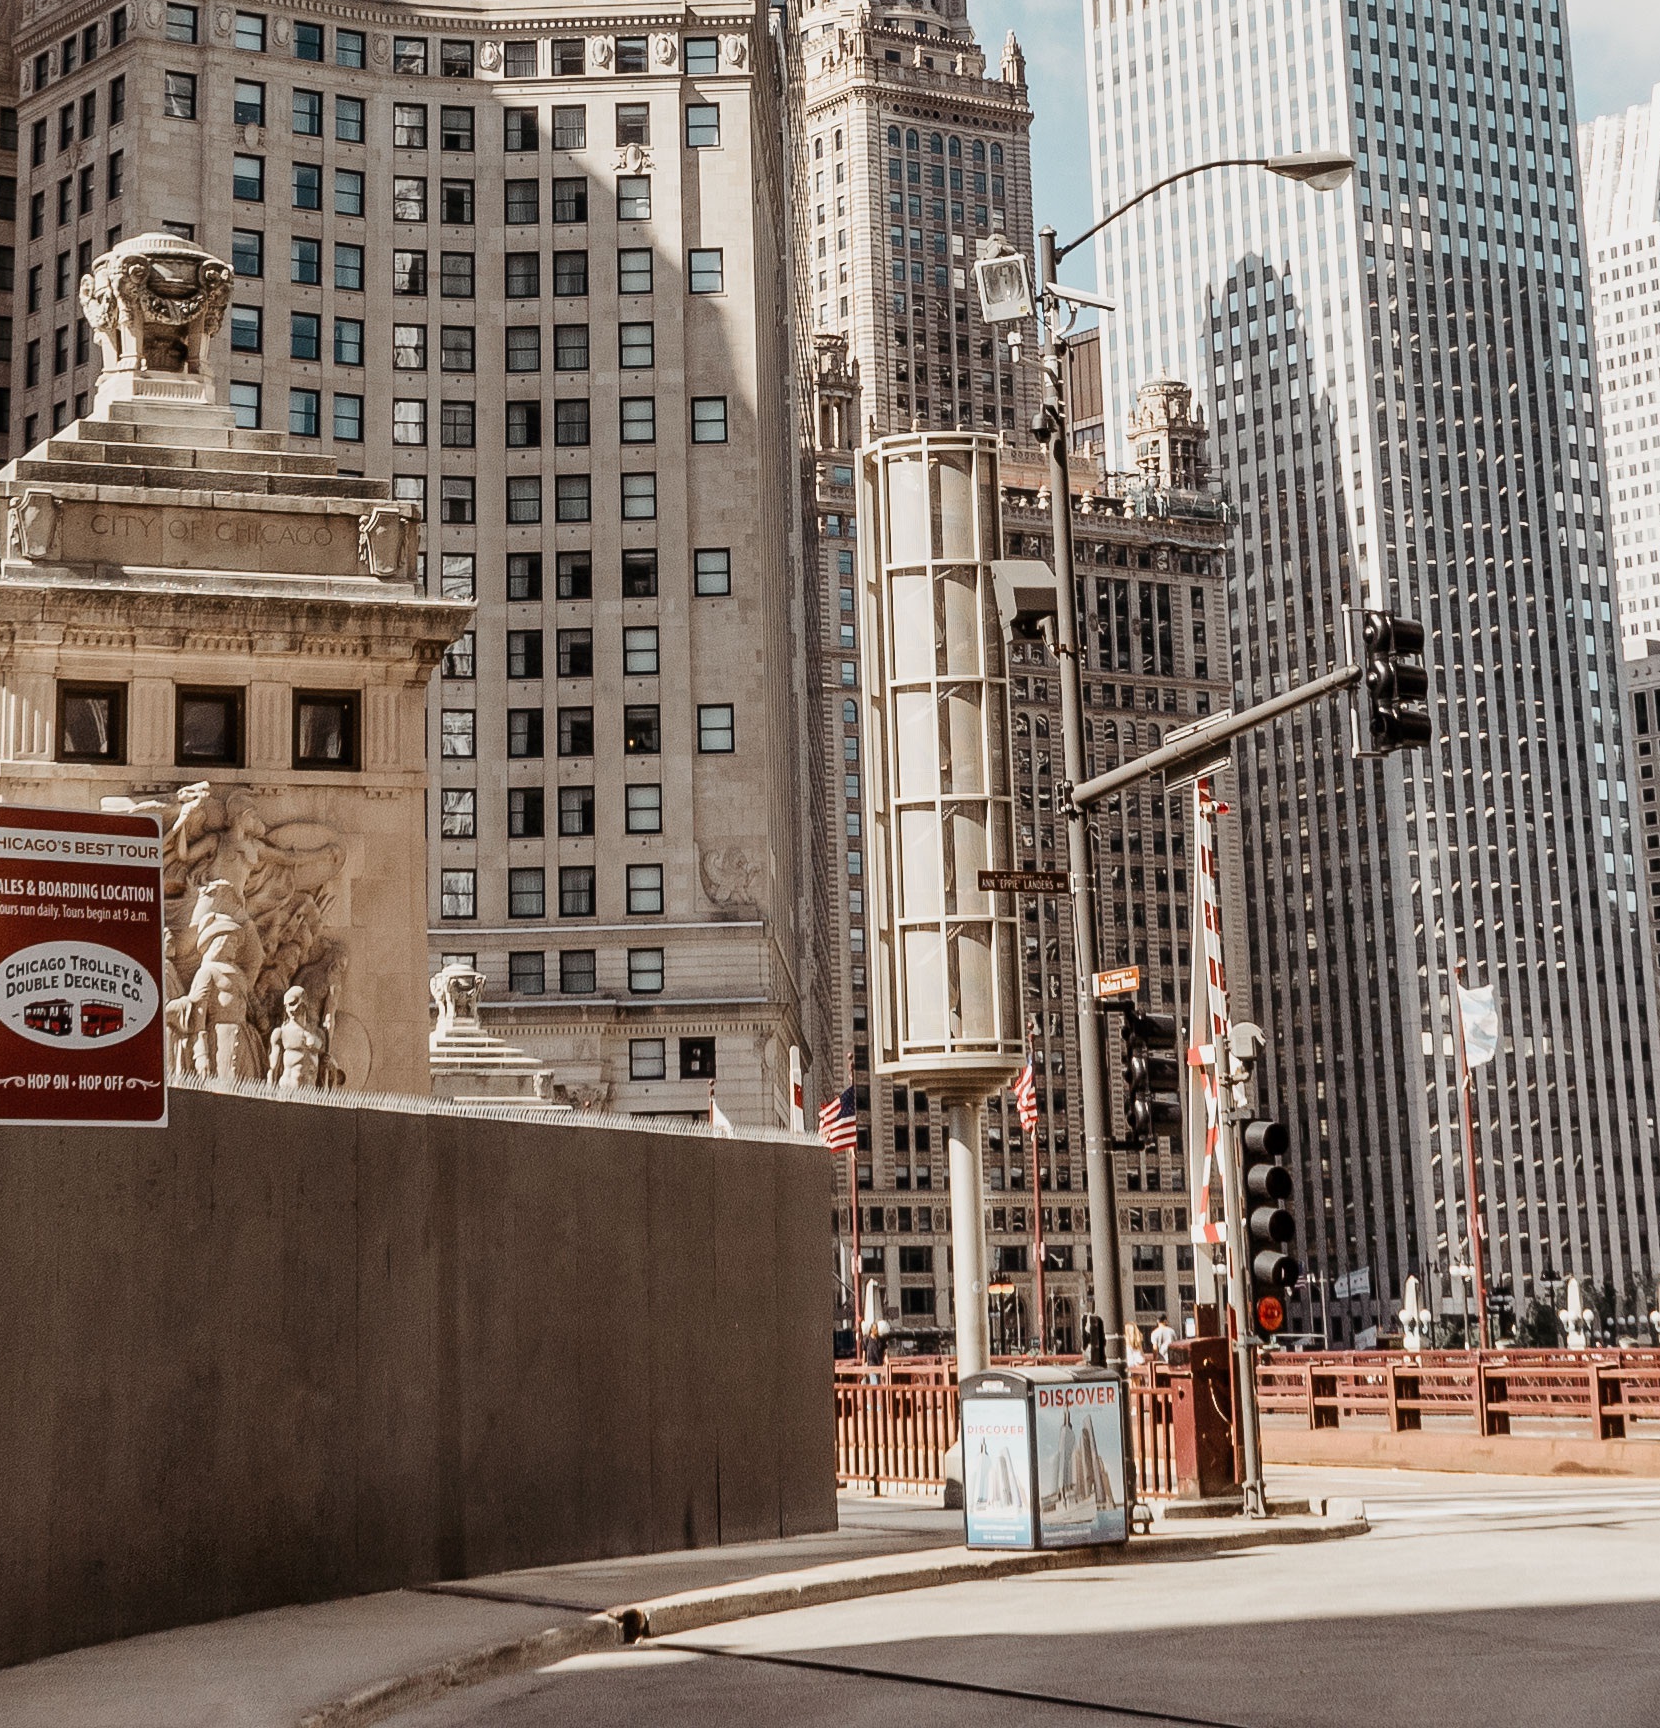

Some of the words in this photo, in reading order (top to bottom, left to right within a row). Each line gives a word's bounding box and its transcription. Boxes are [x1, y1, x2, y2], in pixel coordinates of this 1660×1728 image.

[91, 514, 155, 538] CITY
[168, 521, 204, 541] OF
[215, 522, 334, 547] CHICAGO
[75, 841, 115, 856] BEST
[118, 844, 159, 860] TOUR
[27, 881, 37, 896] &
[39, 880, 99, 900] BOARDING
[101, 884, 154, 903] LOCATION
[20, 905, 36, 916] run
[62, 903, 85, 919] Tours
[86, 907, 112, 924] begin
[113, 909, 122, 921] at
[123, 908, 130, 921] 9
[130, 910, 150, 922] a.m.
[5, 956, 66, 980] CHICAGO
[70, 955, 130, 980] TROLLEY
[132, 969, 143, 986] &
[6, 974, 59, 999] DOUBLE
[64, 973, 117, 994] DECKER
[27, 1073, 51, 1090] HOP
[53, 1074, 70, 1090] ON
[78, 1074, 102, 1091] HOP
[104, 1075, 125, 1091] OFF
[1039, 1386, 1116, 1408] DISCOVER
[967, 1424, 1025, 1436] DISCOVER
